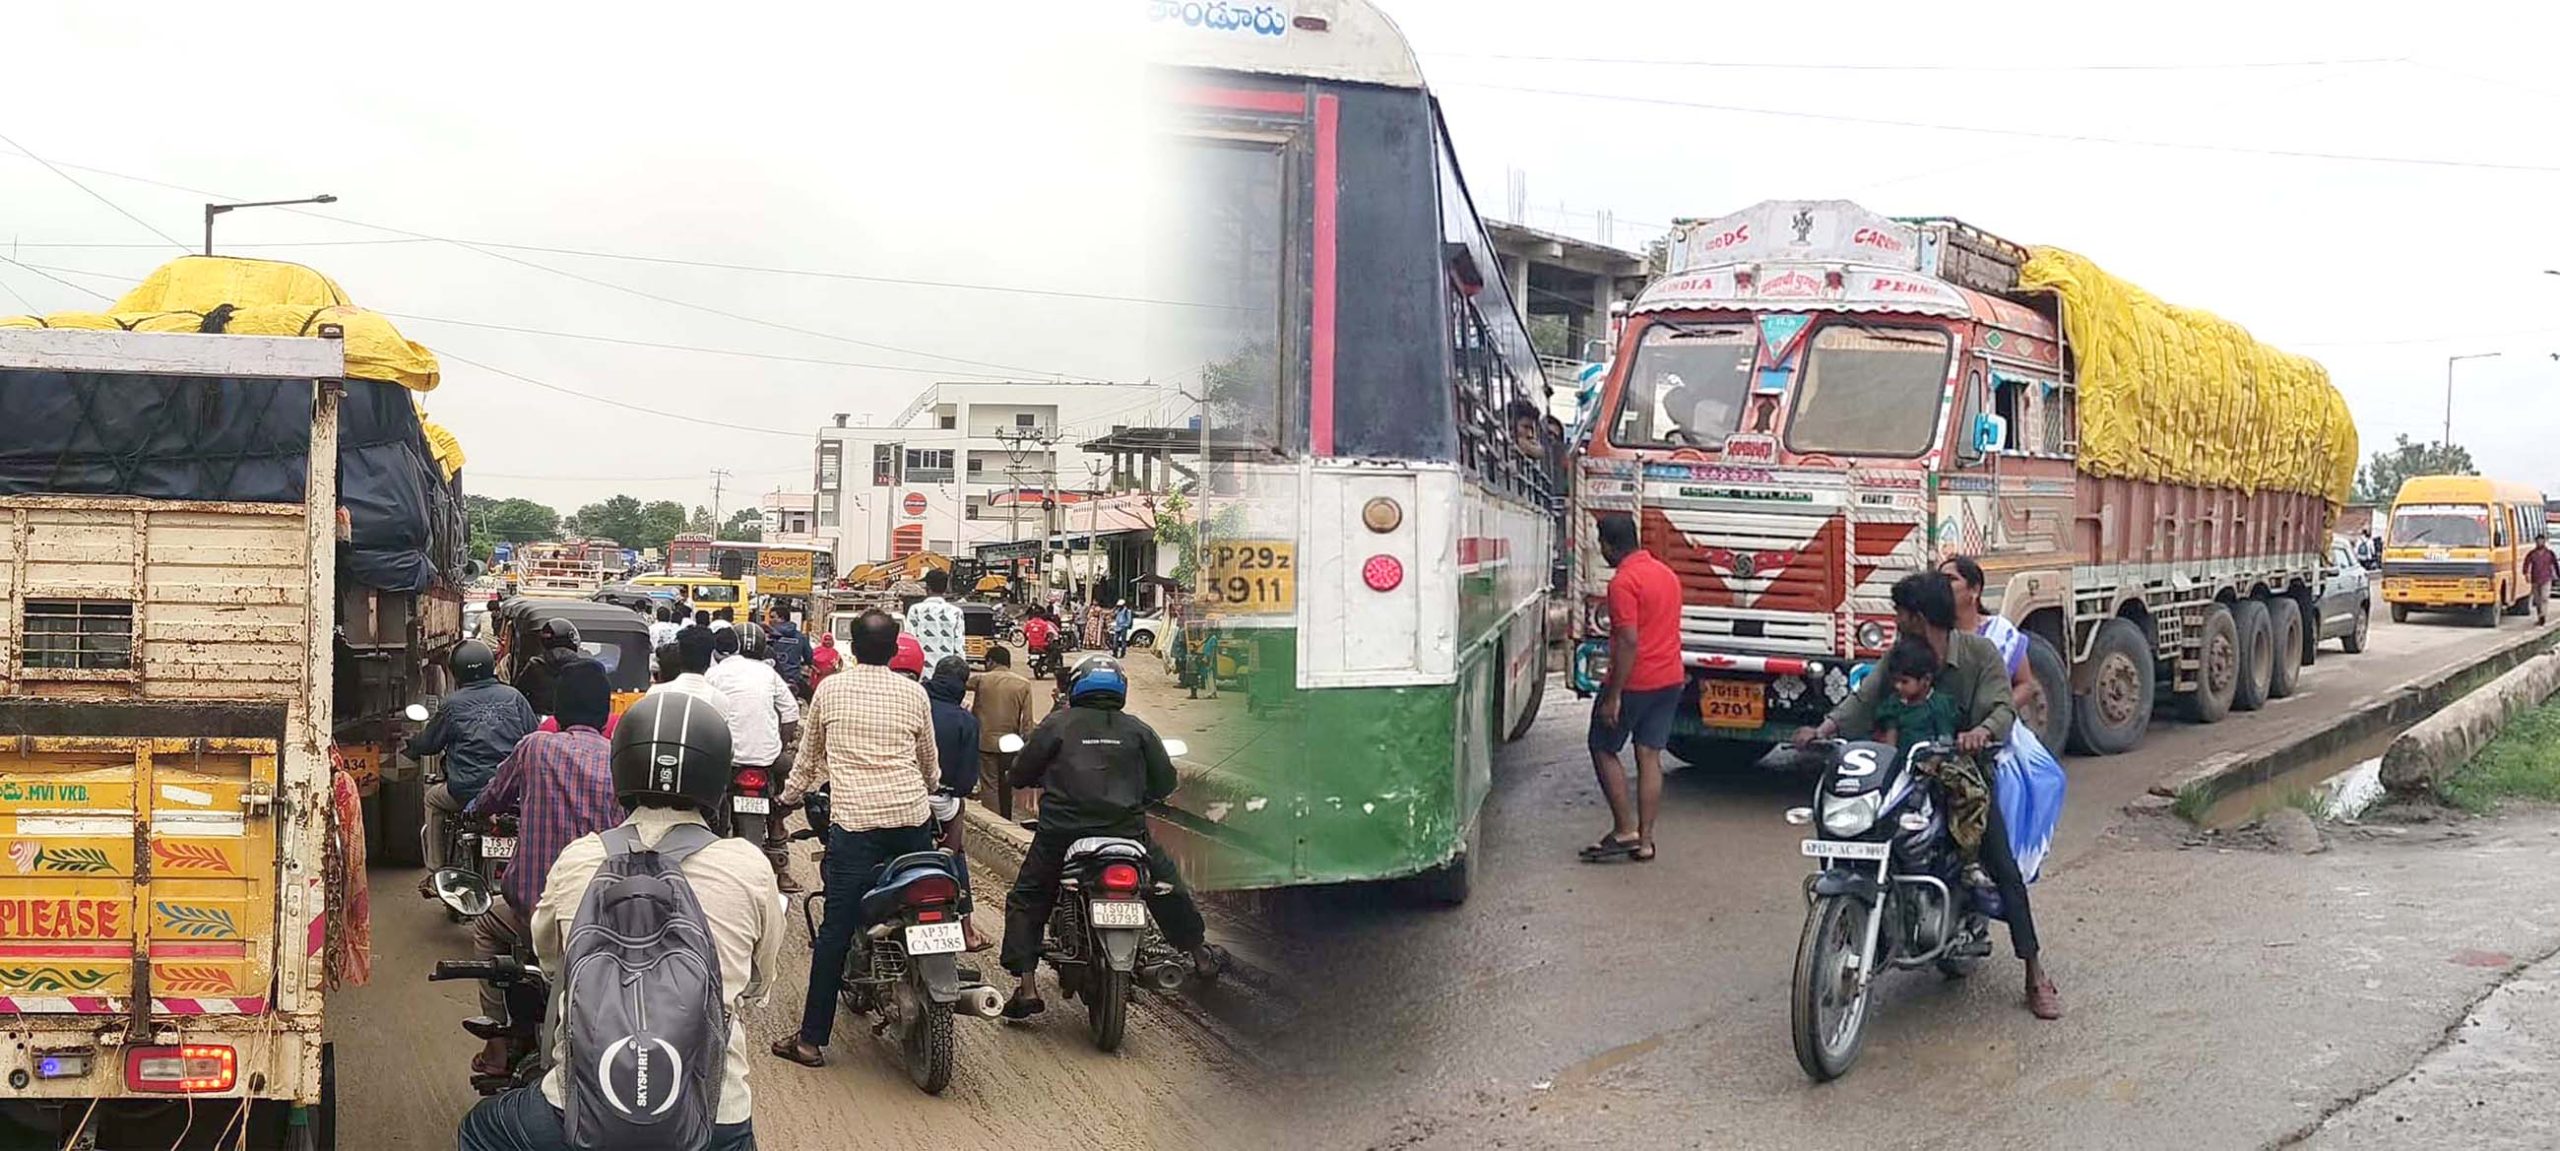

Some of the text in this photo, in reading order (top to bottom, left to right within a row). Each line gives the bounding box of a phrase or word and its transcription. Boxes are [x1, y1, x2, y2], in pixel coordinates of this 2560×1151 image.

[1710, 702, 1753, 716] 2701
[1837, 748, 1877, 776] S
[487, 847, 511, 856] EP27
[637, 1045, 648, 1107] SKYSPIRIT
